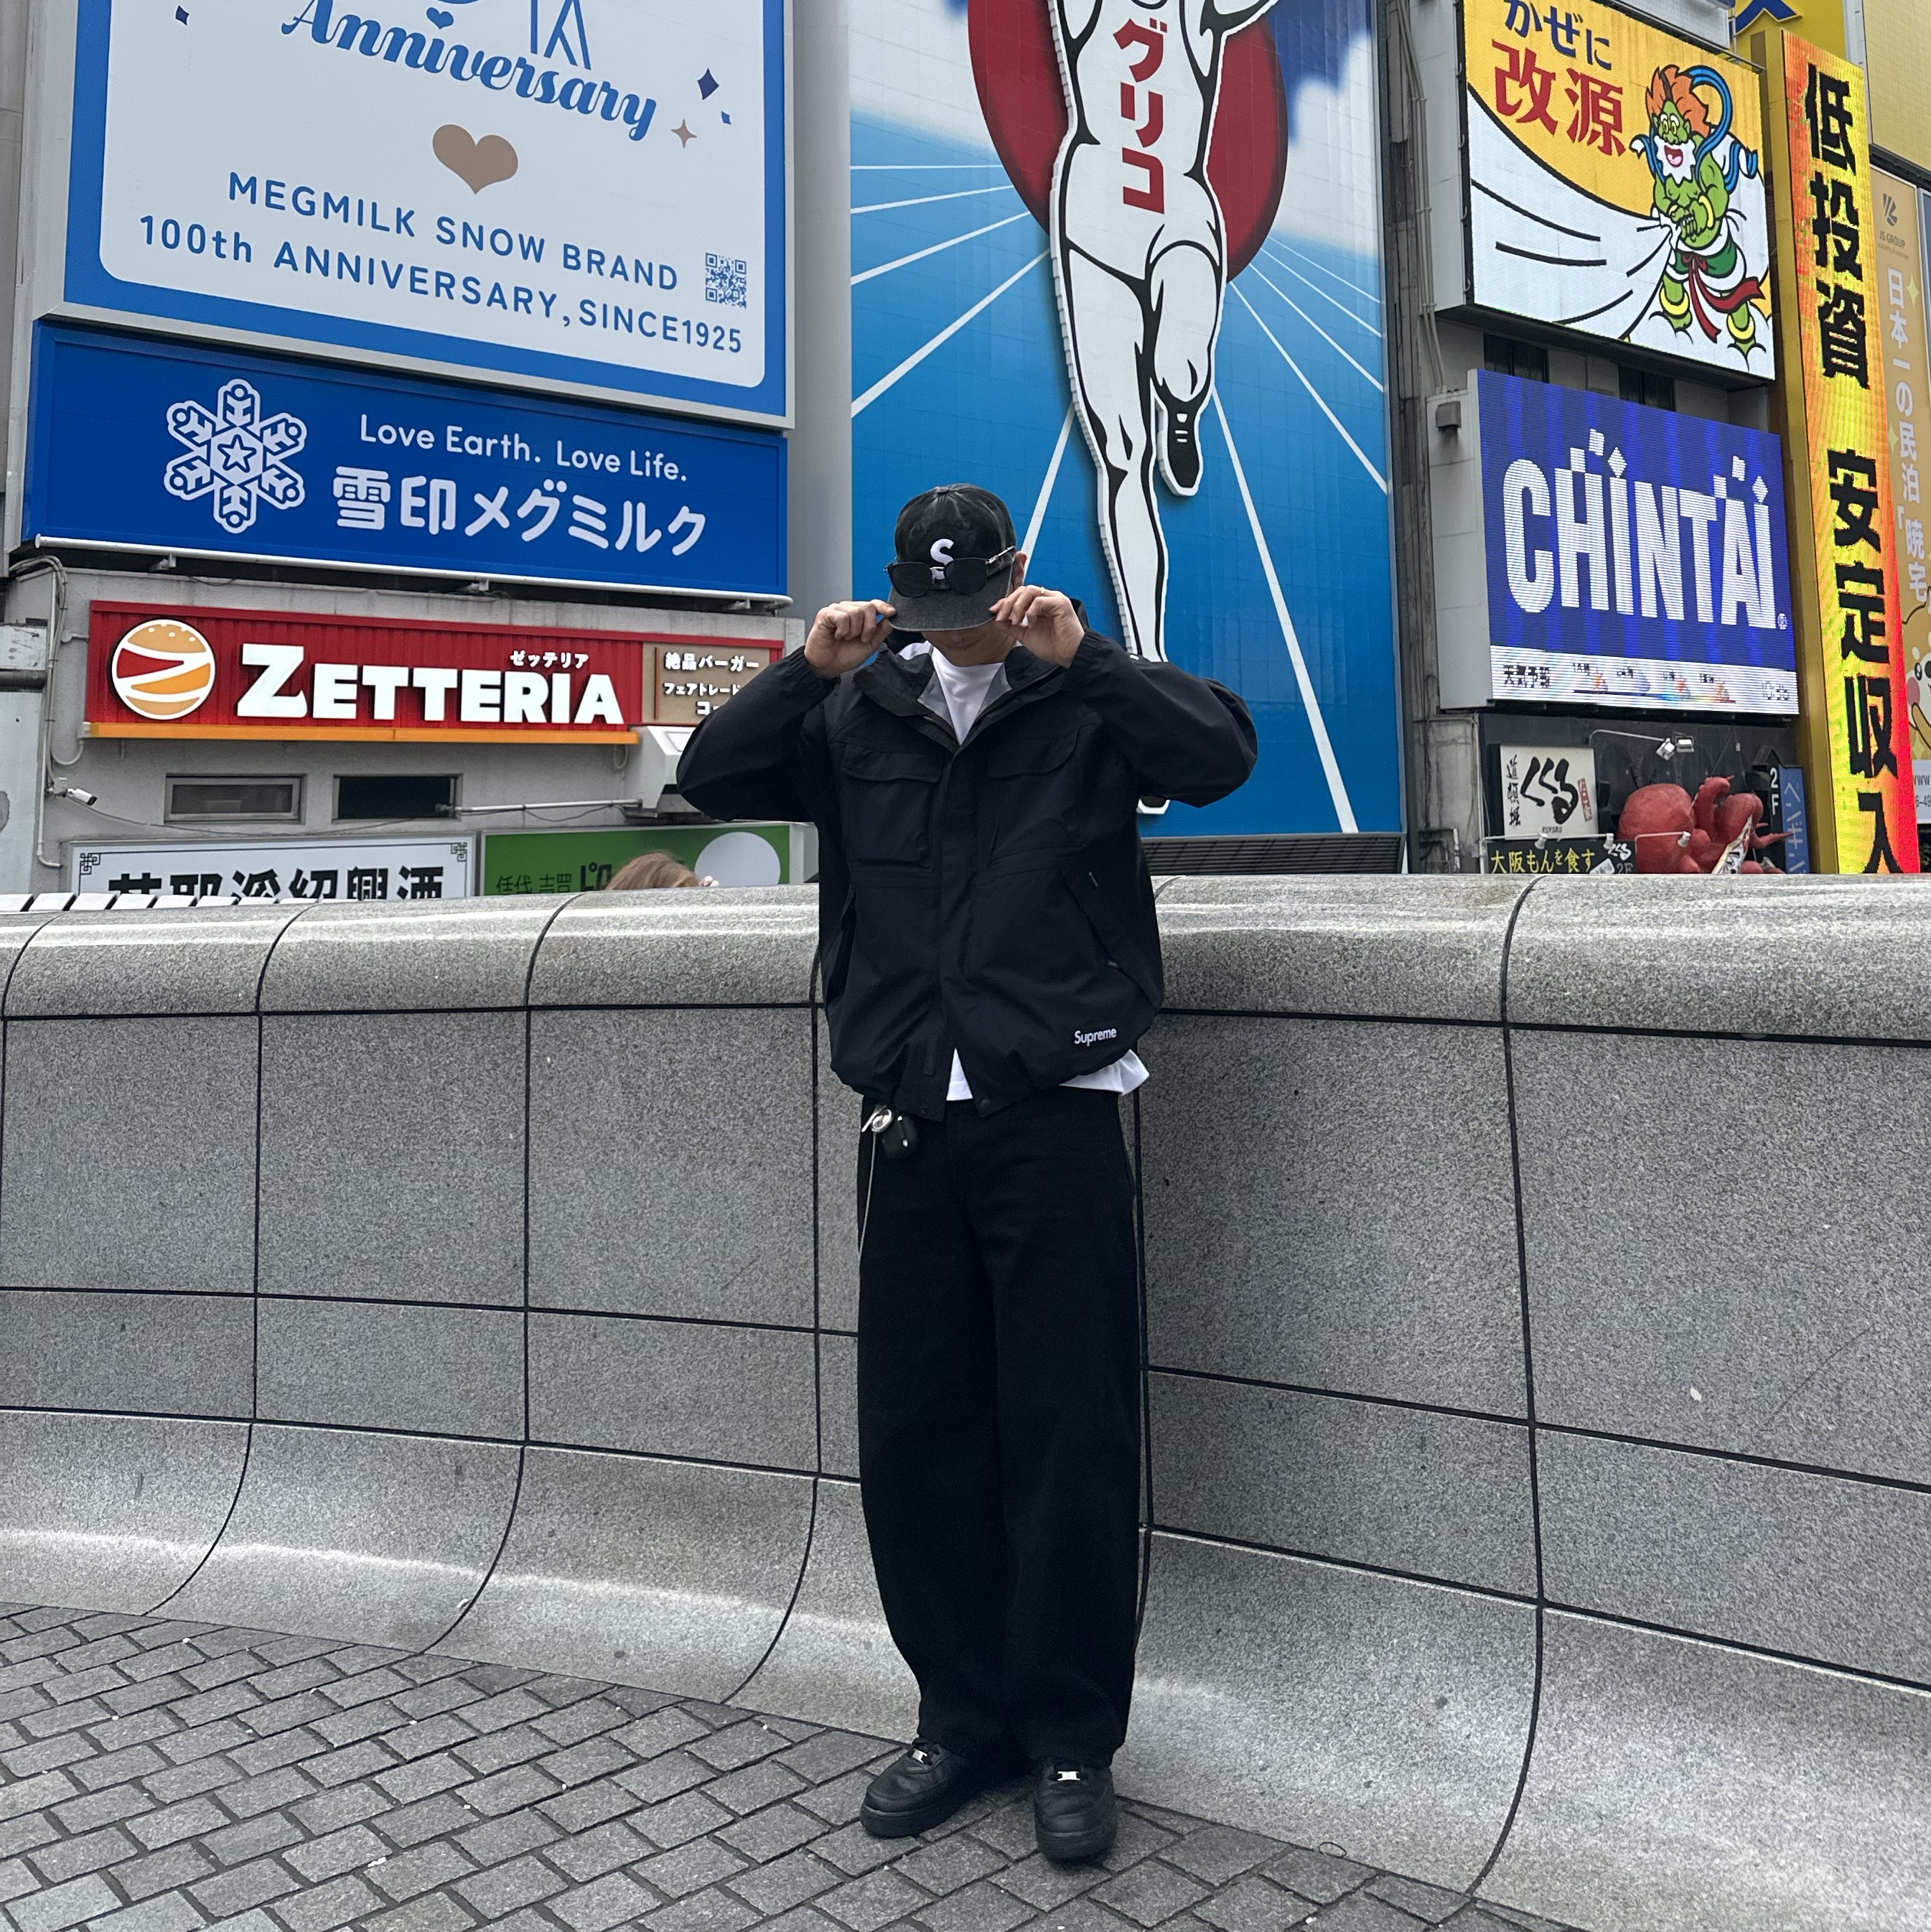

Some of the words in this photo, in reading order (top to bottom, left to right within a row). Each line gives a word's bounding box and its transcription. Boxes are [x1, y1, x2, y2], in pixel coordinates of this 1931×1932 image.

[281, 0, 657, 141] Anniversary
[1503, 0, 1612, 71] かぜに
[1113, 17, 1167, 215] グリコ
[1491, 39, 1627, 157] 改源
[140, 215, 253, 263] 100th
[228, 171, 416, 238] MEGMILK
[435, 216, 546, 263] SNOW
[562, 243, 678, 291] BRAND
[1805, 62, 1871, 391] 低投資
[360, 414, 435, 450] Love
[445, 425, 541, 463] Earth.
[556, 440, 621, 473] Love
[630, 450, 688, 482] Life.
[332, 466, 706, 556] 雪印メグミルク
[1502, 447, 1777, 630] CHINTAI
[930, 538, 955, 581] S
[236, 643, 625, 725] ZETTERIA
[510, 649, 589, 669] ゼッテリア
[665, 651, 759, 673] 絶品バーガー
[1827, 448, 1905, 874] 安定収入
[1074, 1028, 1118, 1047] Supreme
